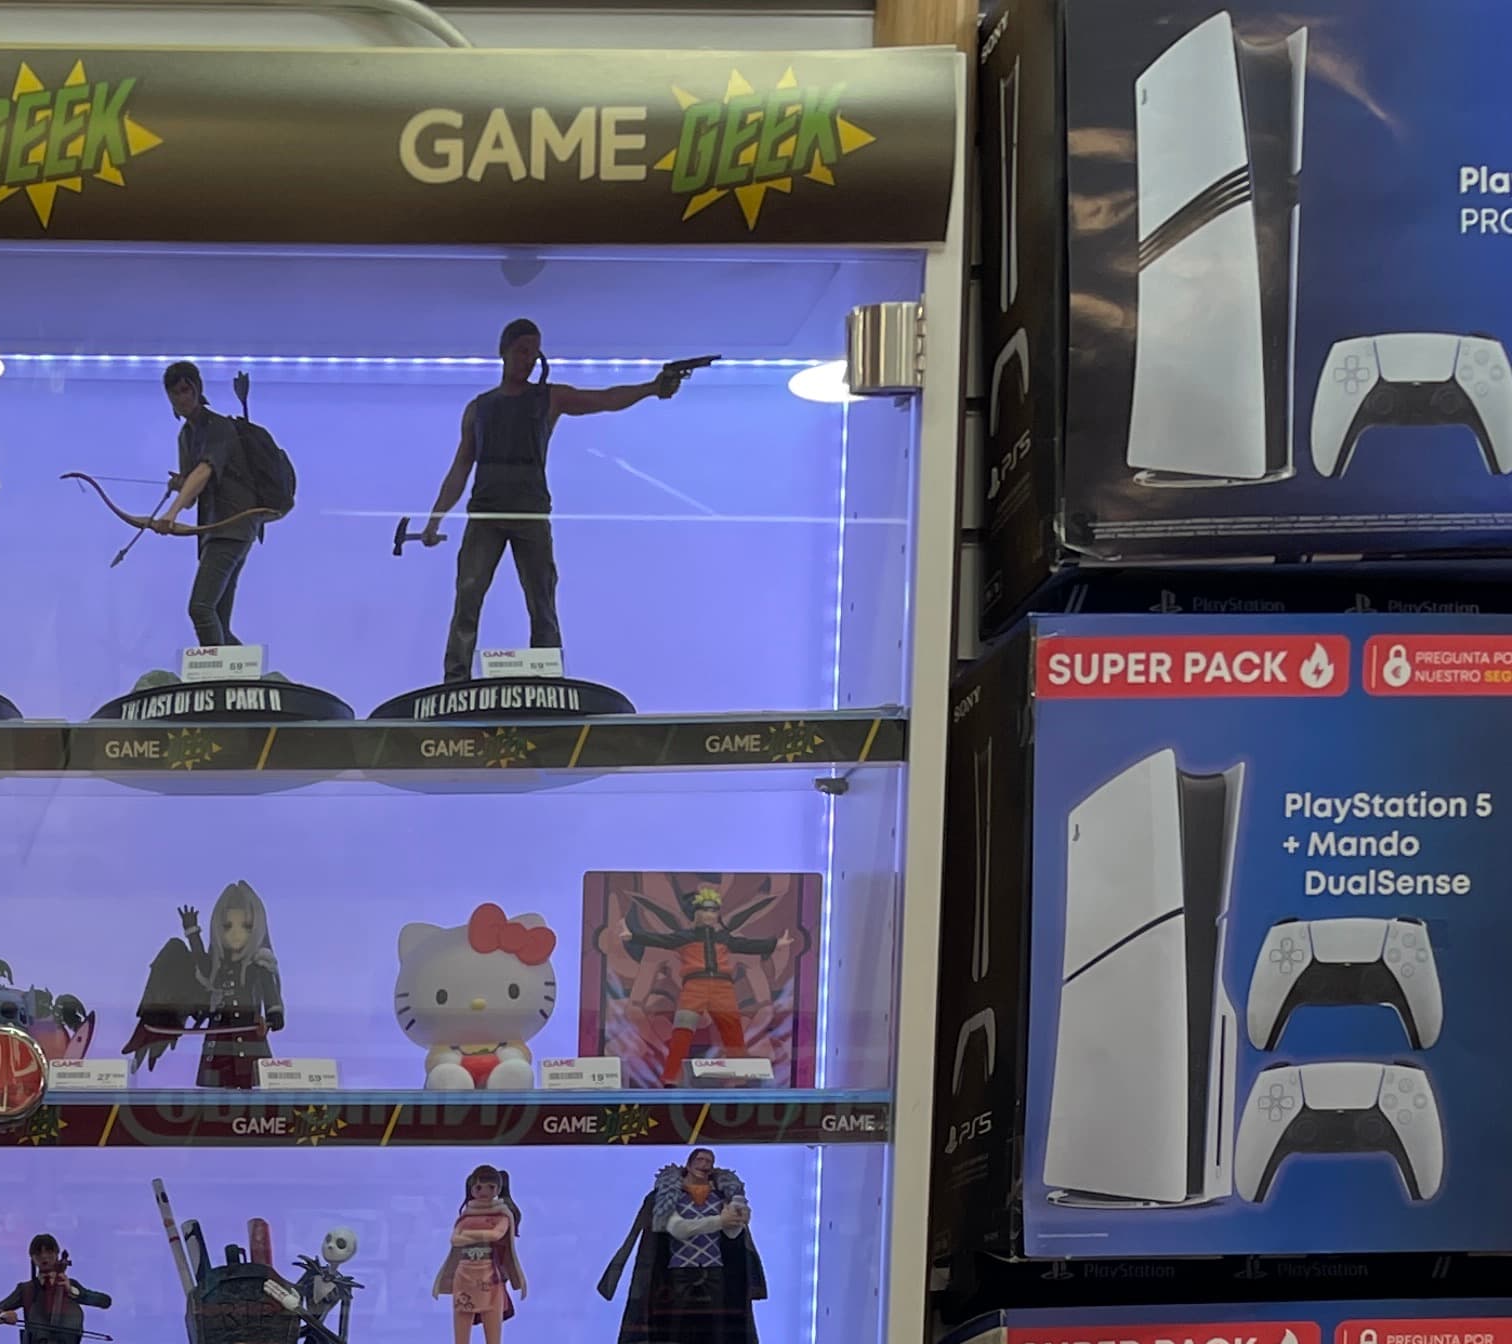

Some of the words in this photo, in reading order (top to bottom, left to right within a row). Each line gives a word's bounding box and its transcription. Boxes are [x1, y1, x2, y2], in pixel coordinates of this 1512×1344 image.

[399, 107, 648, 184] GAME
[671, 82, 848, 194] GEEK
[1048, 651, 1172, 685] SUPER
[1185, 650, 1287, 682] PACK
[1415, 652, 1488, 664] PREGUNTA
[1415, 669, 1481, 683] NUESTRO
[414, 696, 437, 720] THE
[439, 689, 477, 714] LAST
[479, 687, 498, 709] OF
[500, 686, 522, 709] US
[524, 686, 564, 709] PART
[705, 734, 761, 752] GAME
[1284, 793, 1466, 821] PlayStation
[1476, 793, 1493, 816] 5
[1308, 832, 1419, 857] Mando
[1305, 871, 1470, 895] DualSense
[543, 1114, 596, 1133] GAME
